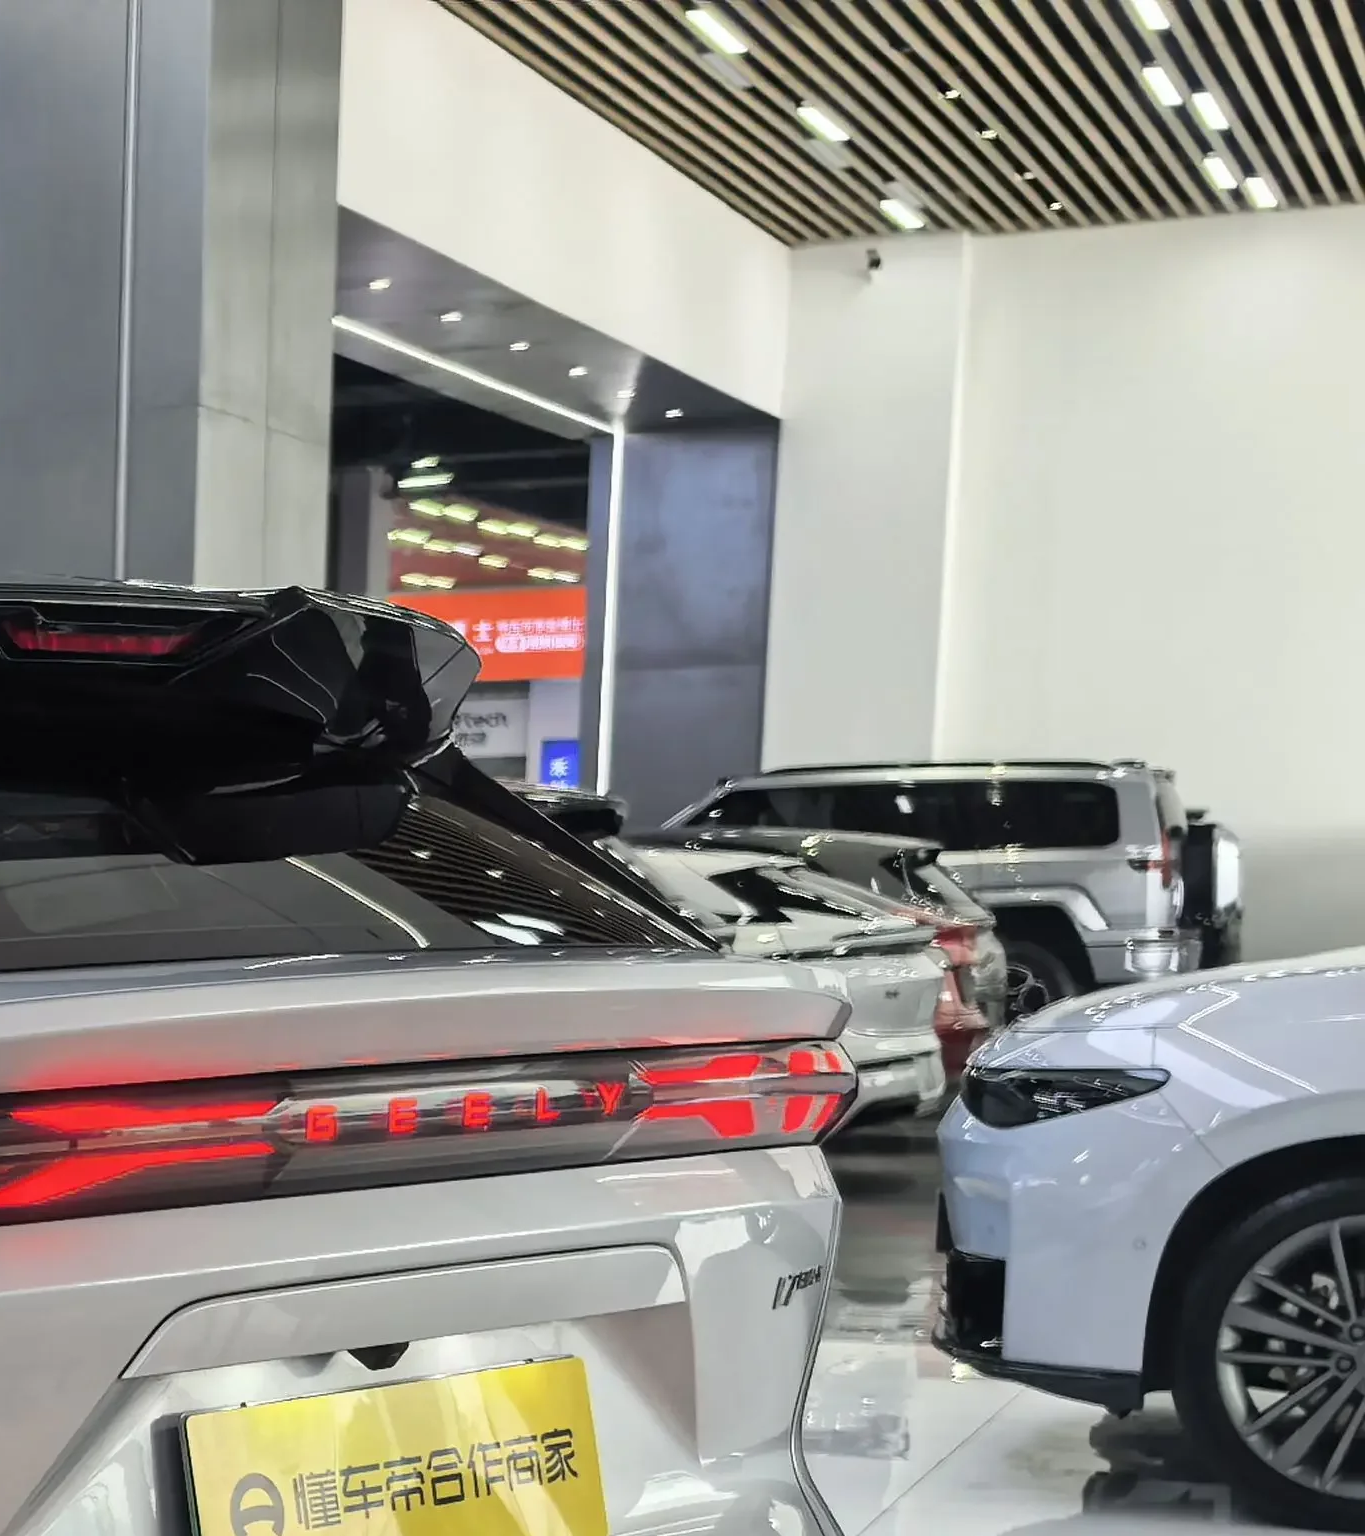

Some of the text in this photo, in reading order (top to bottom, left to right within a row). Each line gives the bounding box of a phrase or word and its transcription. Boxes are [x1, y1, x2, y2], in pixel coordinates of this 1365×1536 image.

[304, 1081, 626, 1143] GEELY
[292, 1428, 579, 1531] 懂车帝合作商家
